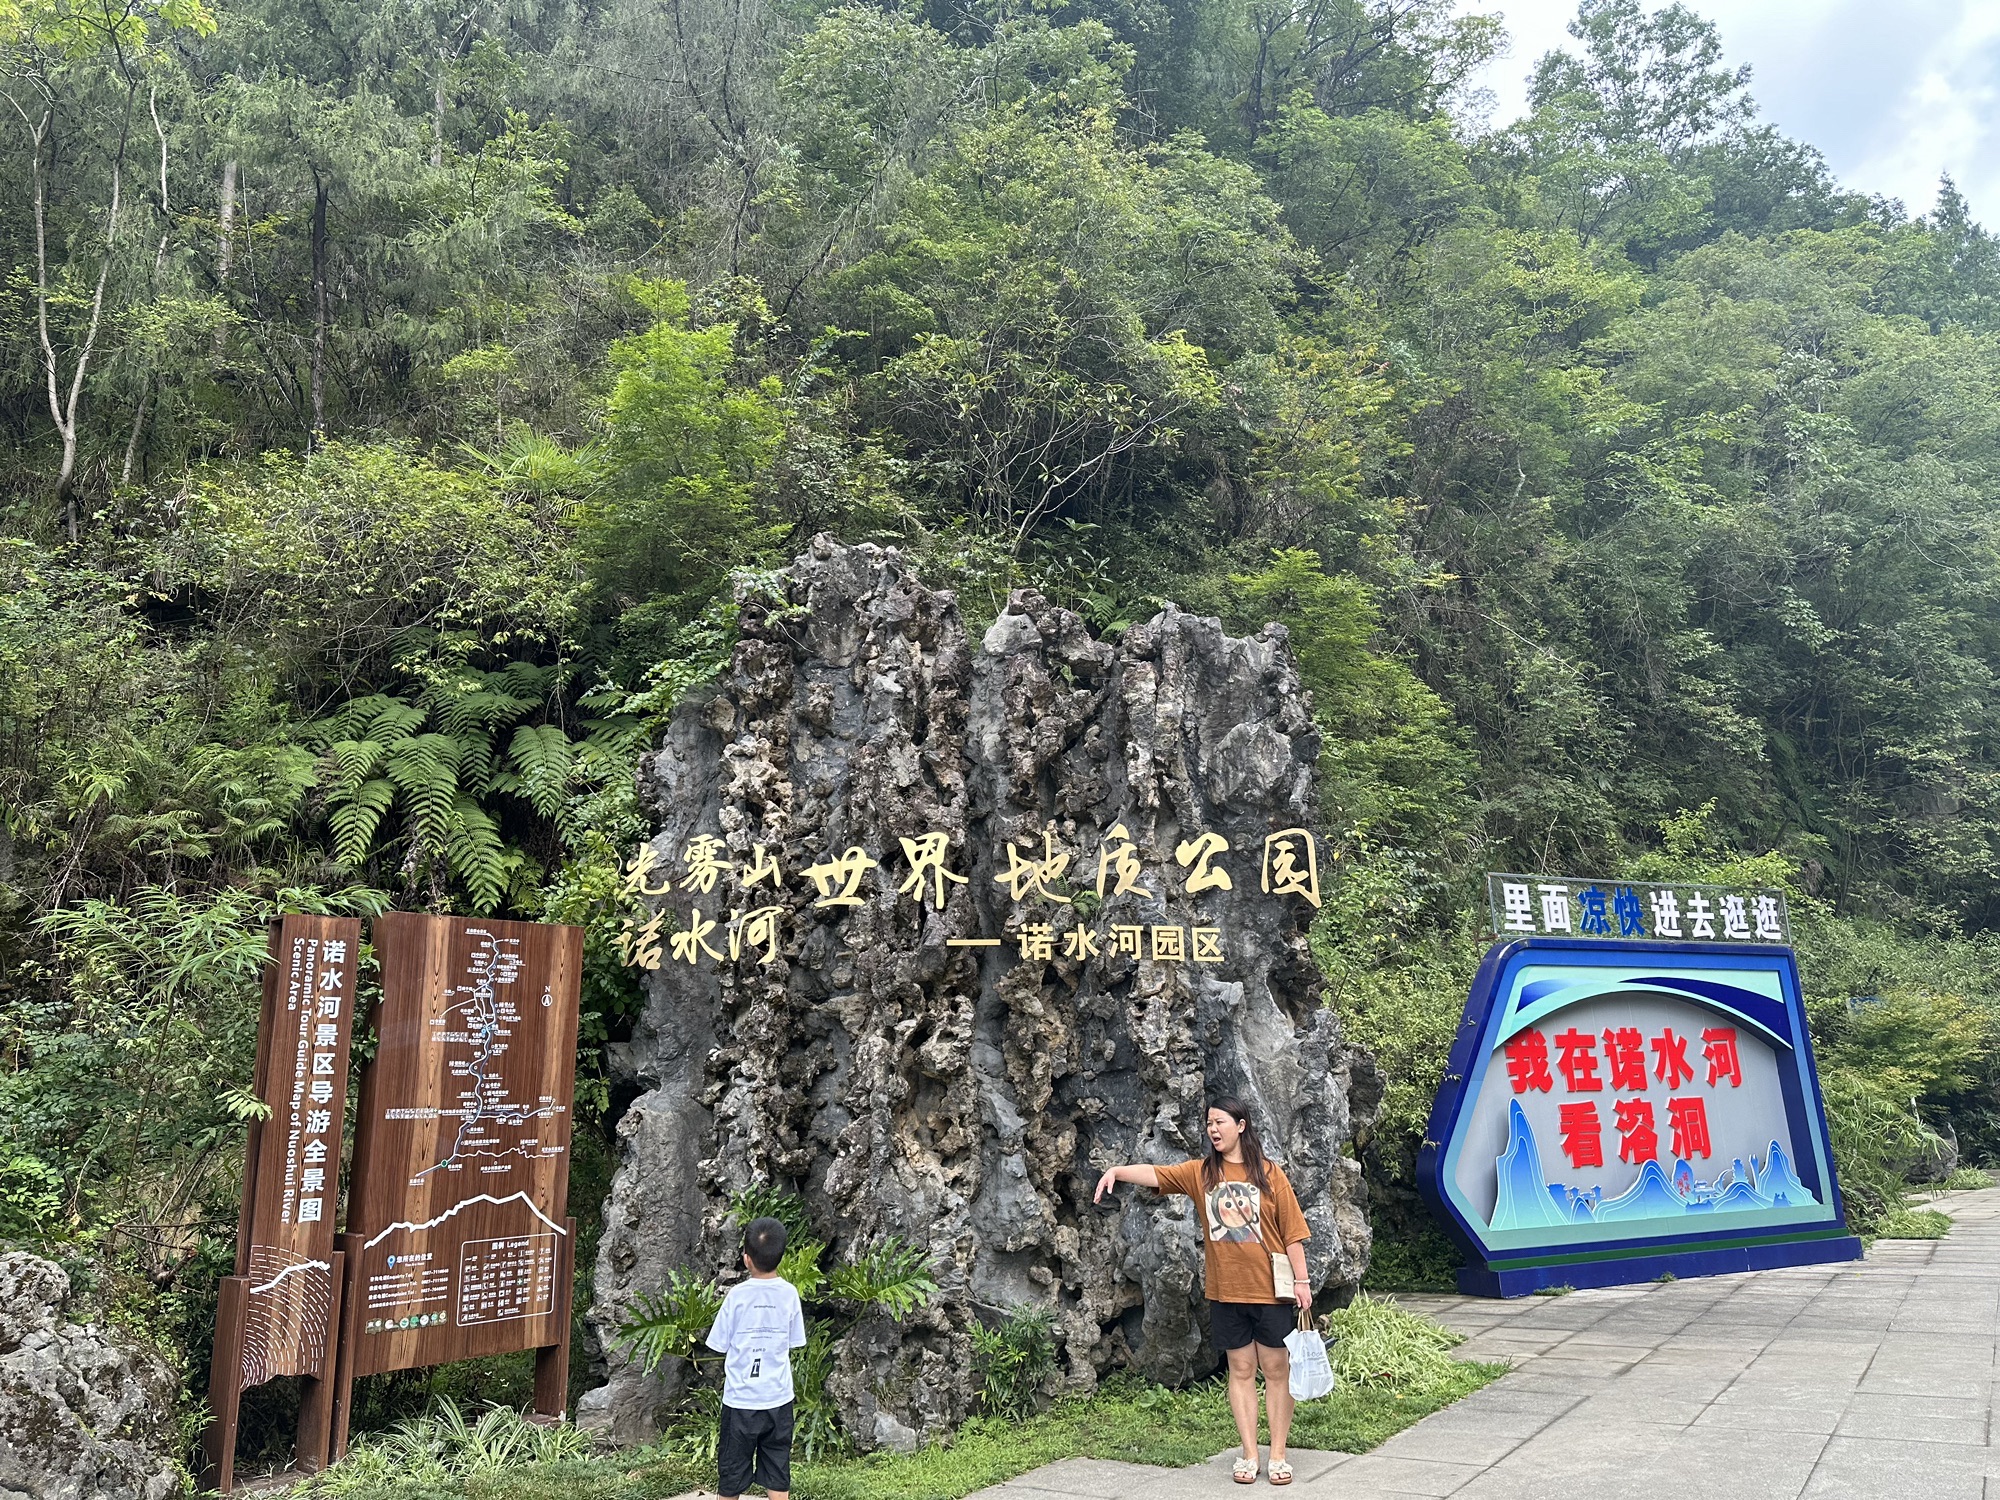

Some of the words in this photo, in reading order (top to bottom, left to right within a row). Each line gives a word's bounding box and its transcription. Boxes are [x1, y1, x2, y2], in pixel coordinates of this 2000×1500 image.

[623, 833, 782, 895] 光雾山
[290, 937, 305, 978] Scenic
[609, 906, 784, 970] 诺水河
[302, 939, 319, 1006] Panoramic
[287, 981, 301, 1011] Area
[299, 1009, 312, 1037] Tour
[295, 1039, 309, 1078] Guide
[1503, 1027, 1743, 1094] 我在诺水河
[289, 1081, 305, 1109] Map
[298, 940, 347, 1223] 诺水河景区导游全景图
[290, 1113, 302, 1127] of
[1557, 1096, 1713, 1169] 看溶洞
[284, 1129, 299, 1186] Nuoshui
[281, 1189, 295, 1224] River
[506, 1239, 529, 1249] Legend
